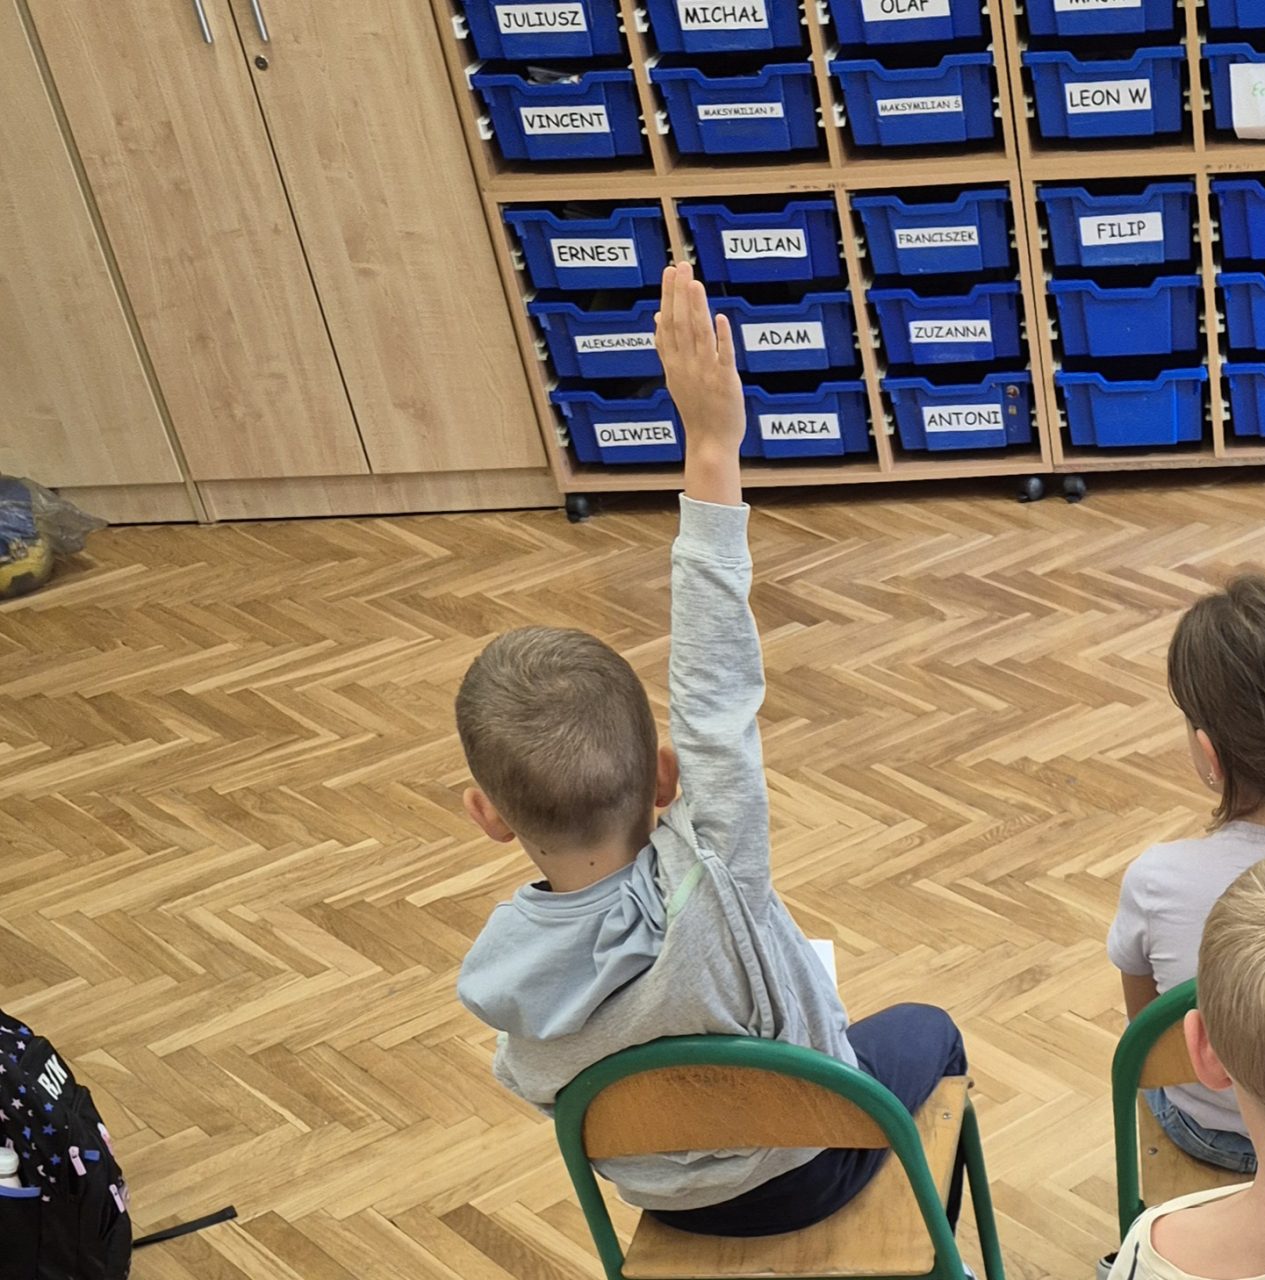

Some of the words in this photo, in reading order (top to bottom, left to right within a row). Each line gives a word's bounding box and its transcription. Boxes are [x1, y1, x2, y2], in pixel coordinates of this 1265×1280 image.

[503, 10, 582, 28] JULIUSZ
[684, 6, 764, 24] MICHAŁ
[1069, 89, 1120, 108] LEON
[1128, 87, 1147, 104] W
[703, 106, 767, 116] MAKSYMILIAN
[880, 100, 951, 113] MAKSYMILIAN
[524, 112, 605, 129] VINCENT
[898, 230, 976, 244] FRANCISZEK
[1096, 220, 1147, 239] FILIP
[729, 236, 801, 254] JULIAN
[558, 245, 631, 262] ERNEST
[758, 329, 811, 344] ADAM
[914, 325, 988, 339] ZUZANNA
[581, 337, 653, 348] ALEKSANDRA
[927, 410, 1002, 428] ANTONI
[600, 428, 673, 443] OLIWIER
[770, 420, 831, 435] MARIA
